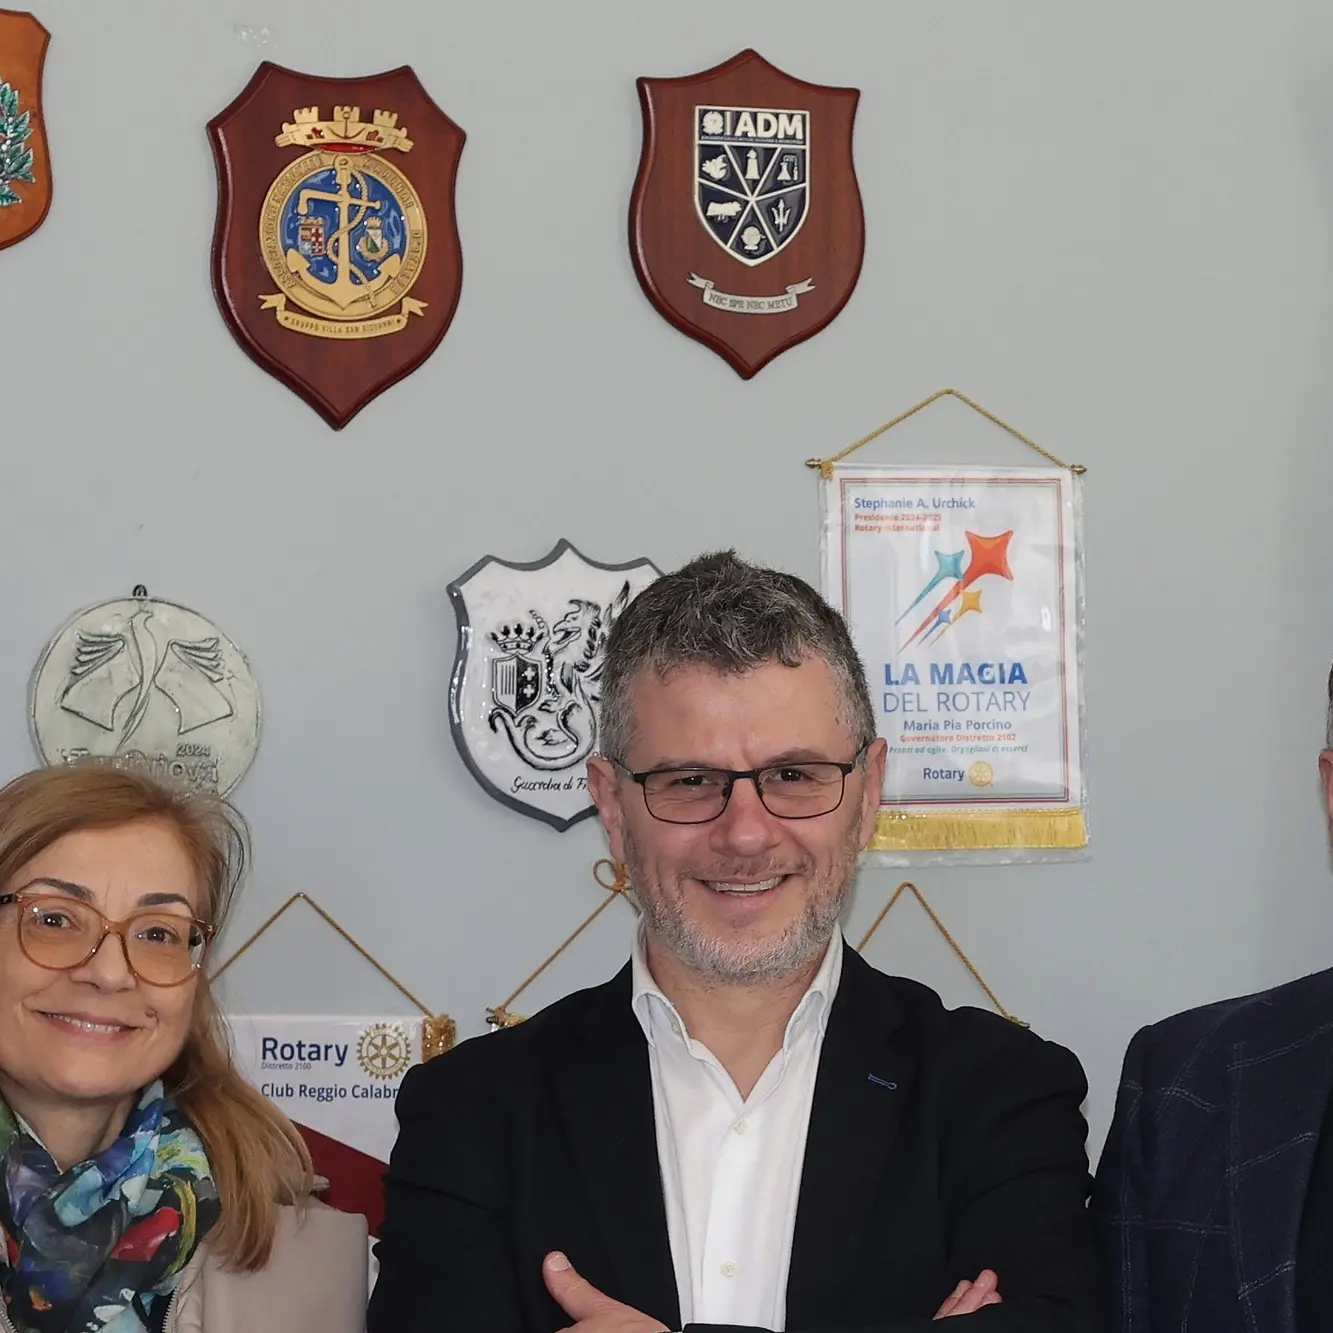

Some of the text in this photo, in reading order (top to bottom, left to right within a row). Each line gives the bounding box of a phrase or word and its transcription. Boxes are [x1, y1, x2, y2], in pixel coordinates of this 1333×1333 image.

[734, 112, 804, 139] ADM
[708, 292, 728, 306] NEC
[747, 300, 766, 310] NEC
[854, 498, 976, 511] Stephanie A. Urchick
[854, 524, 882, 533] Rotary
[884, 662, 1028, 686] LA MAGIA
[883, 691, 1031, 713] DEL ROTARY
[903, 719, 1012, 731] Maria Pia Porcino
[996, 734, 1017, 742] 2102
[176, 743, 211, 757] 2024
[923, 767, 965, 782] Rotary
[511, 776, 561, 793] Guardia
[563, 776, 574, 790] di
[262, 1037, 349, 1067] Rotary
[261, 1061, 293, 1070] Distretto
[261, 1084, 400, 1102] Club Reggio Calabr
